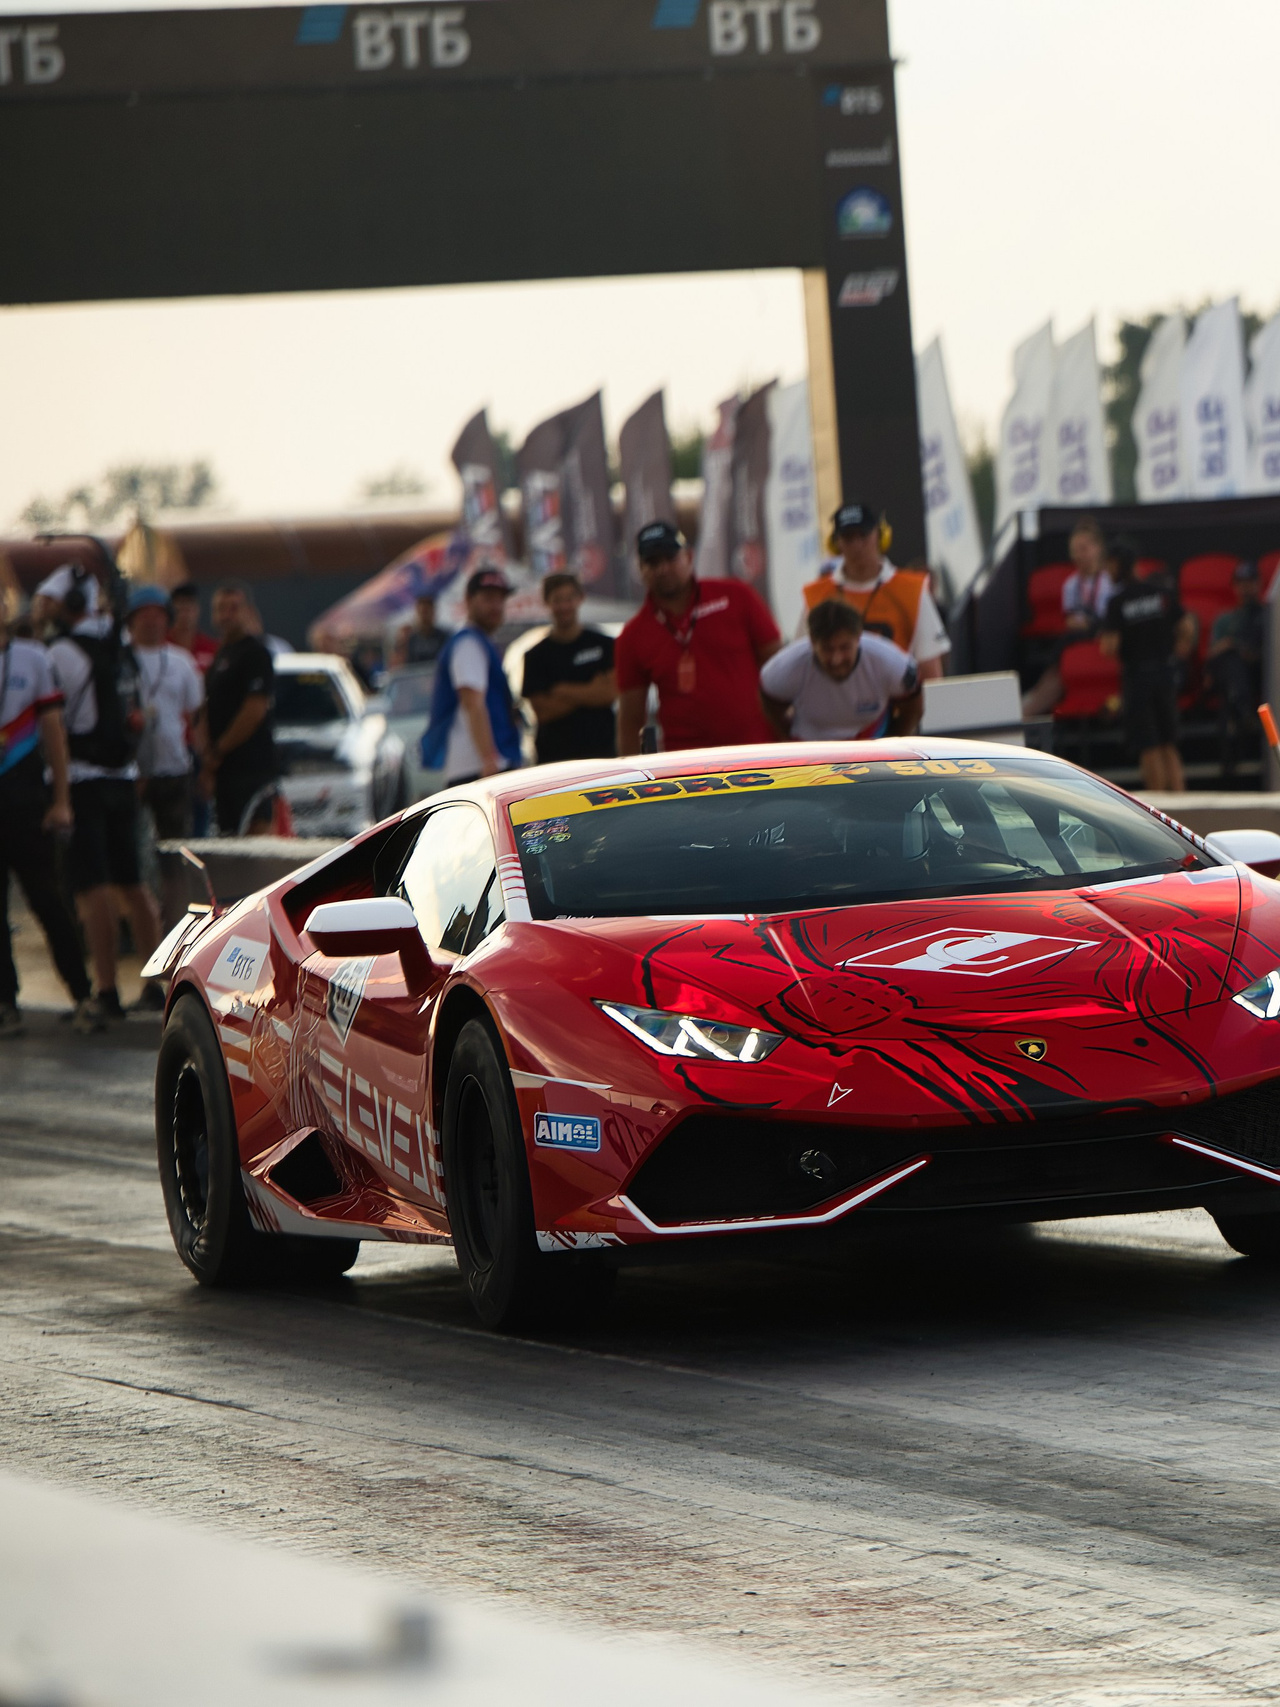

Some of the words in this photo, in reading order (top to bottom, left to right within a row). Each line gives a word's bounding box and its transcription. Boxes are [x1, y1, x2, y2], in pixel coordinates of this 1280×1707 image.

[353, 6, 471, 71] ВТБ
[707, 0, 822, 55] ВТБ
[840, 86, 883, 115] ВТБ
[579, 773, 775, 806] RDRC
[886, 760, 996, 775] 503
[537, 1120, 597, 1142] AIMOL
